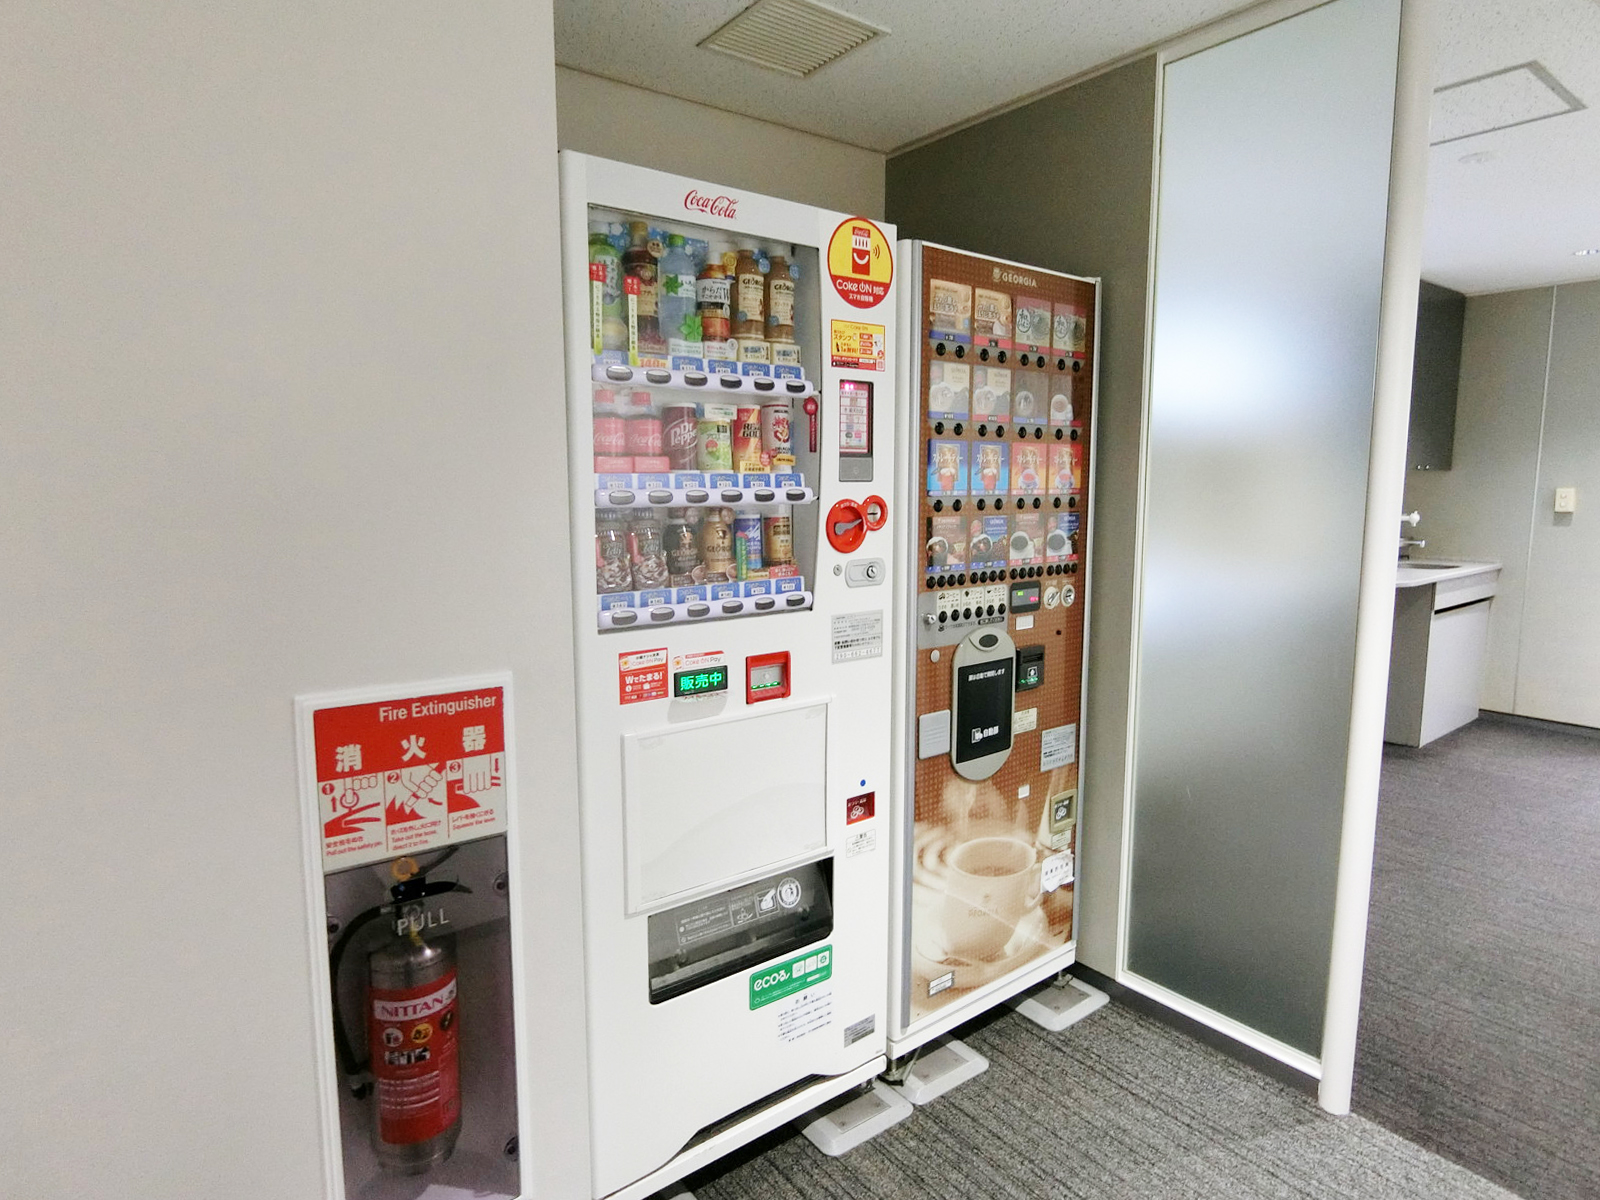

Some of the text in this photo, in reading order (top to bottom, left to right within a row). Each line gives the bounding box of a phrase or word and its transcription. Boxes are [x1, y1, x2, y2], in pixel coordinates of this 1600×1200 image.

[683, 189, 738, 219] Coca-Cola
[836, 279, 885, 295] Coke ON 対応
[1001, 271, 1038, 288] GEORGIA
[848, 293, 874, 303] スマホ自販機
[680, 421, 693, 433] Dr
[680, 671, 722, 691] 販売中
[379, 695, 497, 722] Fire Extinguisher
[396, 907, 451, 936] PULL
[381, 996, 444, 1017] NITTAN
